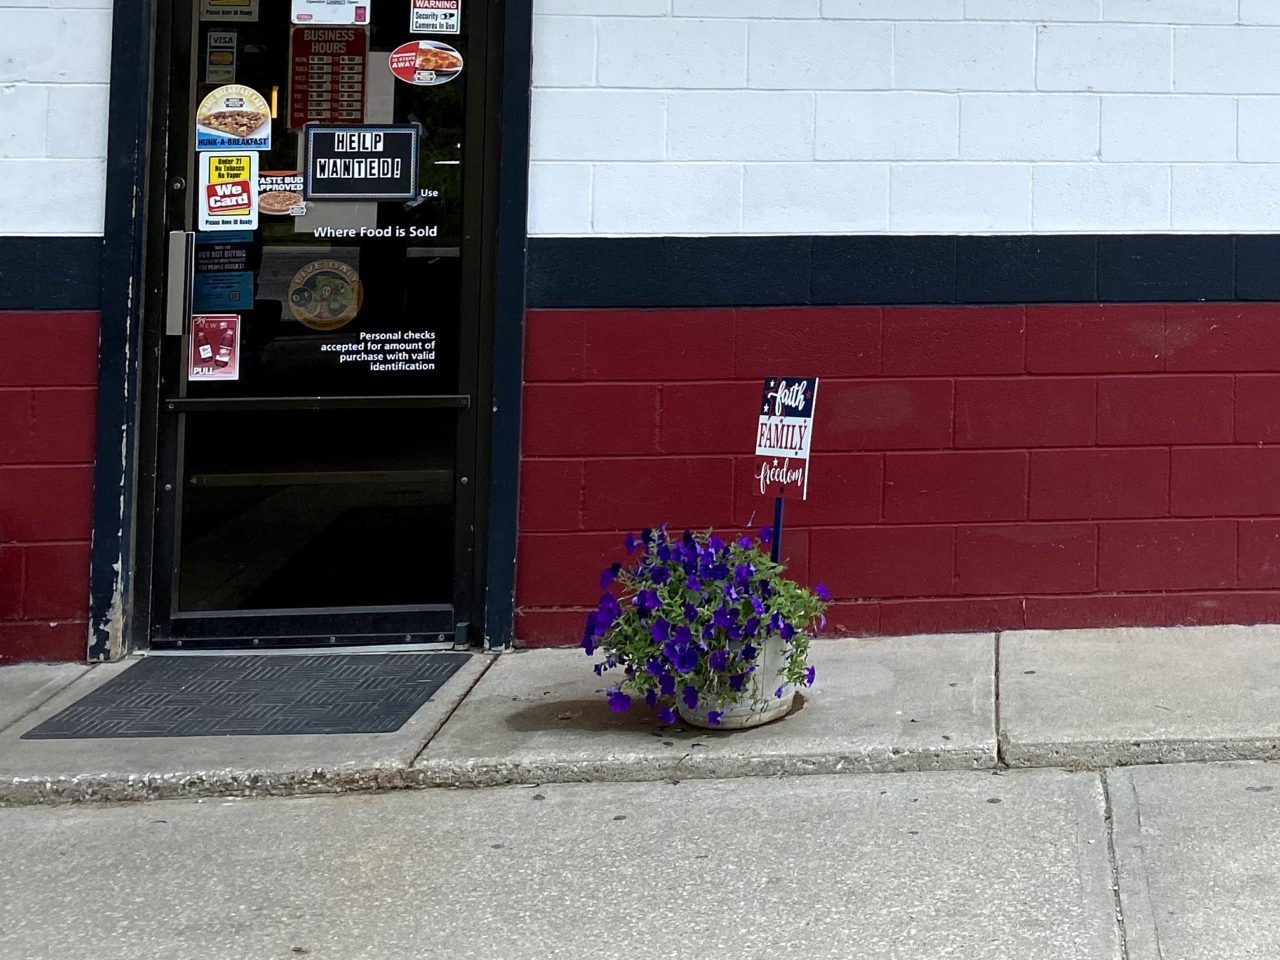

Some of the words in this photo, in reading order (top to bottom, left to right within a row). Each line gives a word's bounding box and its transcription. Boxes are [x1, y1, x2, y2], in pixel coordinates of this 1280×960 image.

[415, 0, 457, 9] WARNING
[415, 11, 439, 21] Security
[414, 21, 438, 29] Cameras
[438, 21, 445, 29] In
[445, 22, 455, 30] Use
[213, 36, 233, 44] VISA
[303, 29, 356, 41] BUSINESS
[311, 41, 347, 54] HOURS
[391, 60, 415, 68] AWAY
[198, 137, 267, 146] HUNK-A-BREAKFAST
[335, 132, 383, 151] HELP
[317, 159, 401, 178] WANTED!
[284, 176, 304, 184] BUD
[215, 184, 242, 196] We
[421, 189, 439, 197] Use
[209, 193, 248, 208] Card
[314, 226, 357, 237] Where
[360, 226, 392, 237] Food
[396, 226, 406, 237] is
[409, 225, 438, 237] Sold
[224, 249, 246, 258] BUYING
[294, 263, 322, 284] LIVE
[360, 331, 401, 340] Personal
[403, 330, 436, 340] checks
[320, 342, 365, 353] accepted
[367, 341, 382, 350] for
[384, 341, 423, 350] amount
[424, 340, 436, 350] of
[340, 352, 384, 363] purchase
[386, 351, 409, 360] with
[411, 351, 435, 360] valid
[193, 367, 215, 375] PULL
[370, 361, 435, 371] identification
[767, 380, 808, 416] faith
[758, 422, 808, 451] FAMILY
[755, 457, 804, 495] freedom
